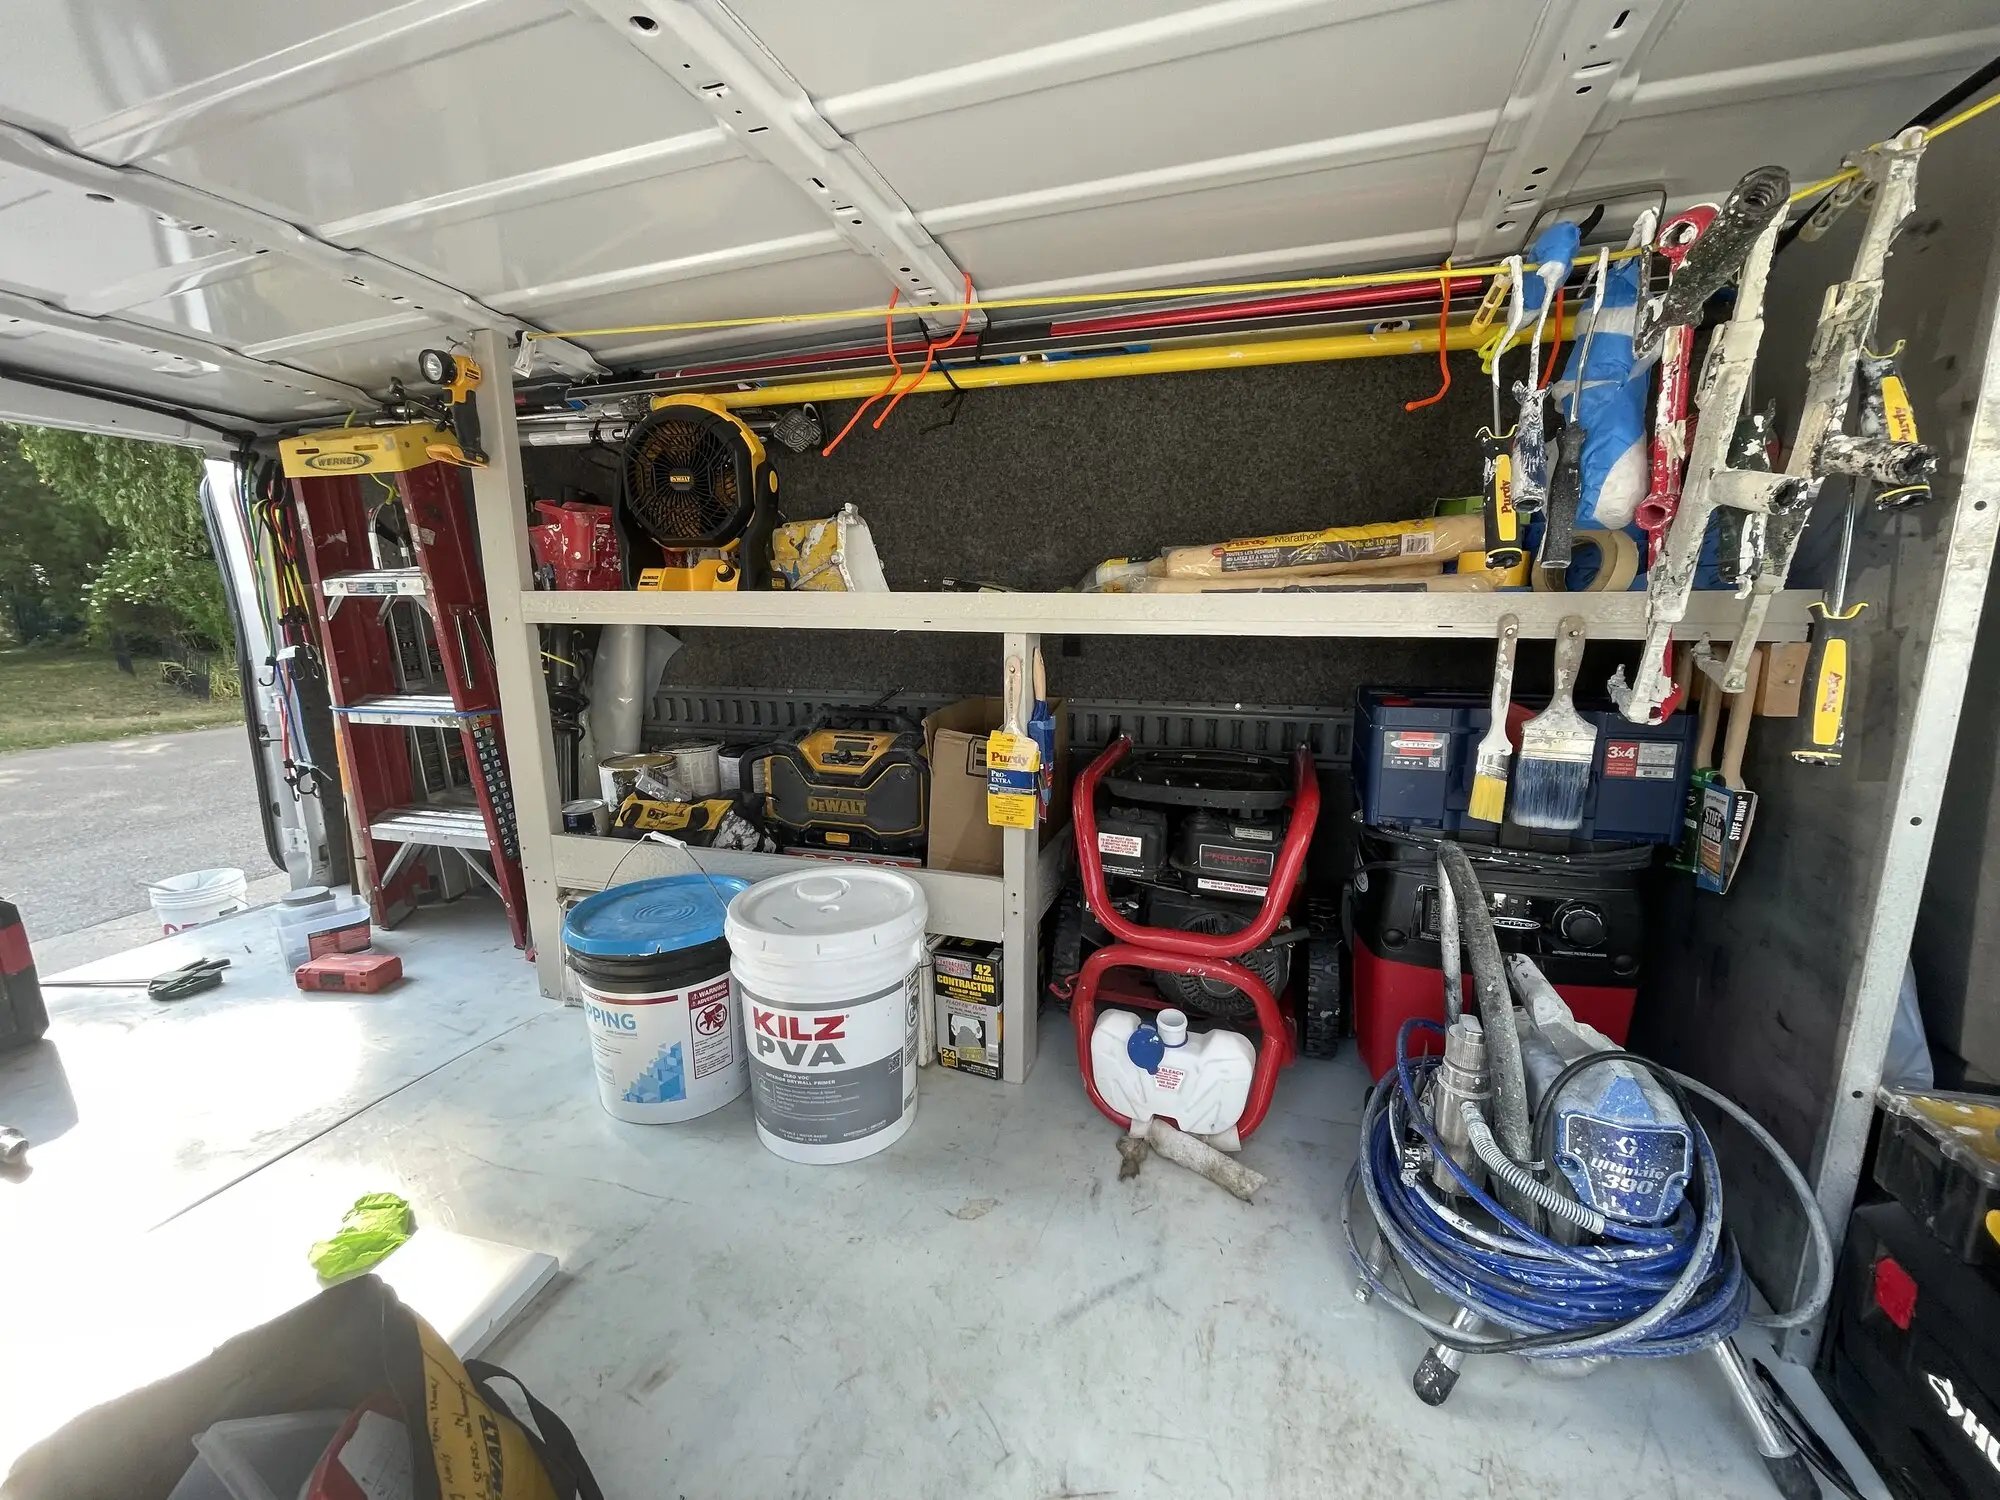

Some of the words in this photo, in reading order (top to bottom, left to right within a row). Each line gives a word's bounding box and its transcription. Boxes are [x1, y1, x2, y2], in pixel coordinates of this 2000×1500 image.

[317, 456, 363, 467] WERNER
[1500, 480, 1512, 514] Purdy
[1274, 532, 1322, 544] Marathon
[991, 751, 1029, 767] Purdy
[991, 777, 1012, 785] EXTRA
[808, 798, 867, 815] DEWALT
[1704, 807, 1722, 827] STIFF
[1728, 820, 1743, 840] STIFF
[1736, 800, 1748, 822] BRUSH
[1204, 851, 1267, 864] PREDATOR
[974, 963, 992, 976] 42
[936, 974, 995, 993] CONTRACTOR
[973, 975, 995, 983] GALLON
[698, 982, 727, 998] WARNING
[752, 1006, 846, 1041] KILZ
[755, 1032, 846, 1067] PVA
[942, 1048, 956, 1059] 24
[1161, 1068, 1184, 1076] BLEACH
[1601, 1173, 1655, 1195] 390
